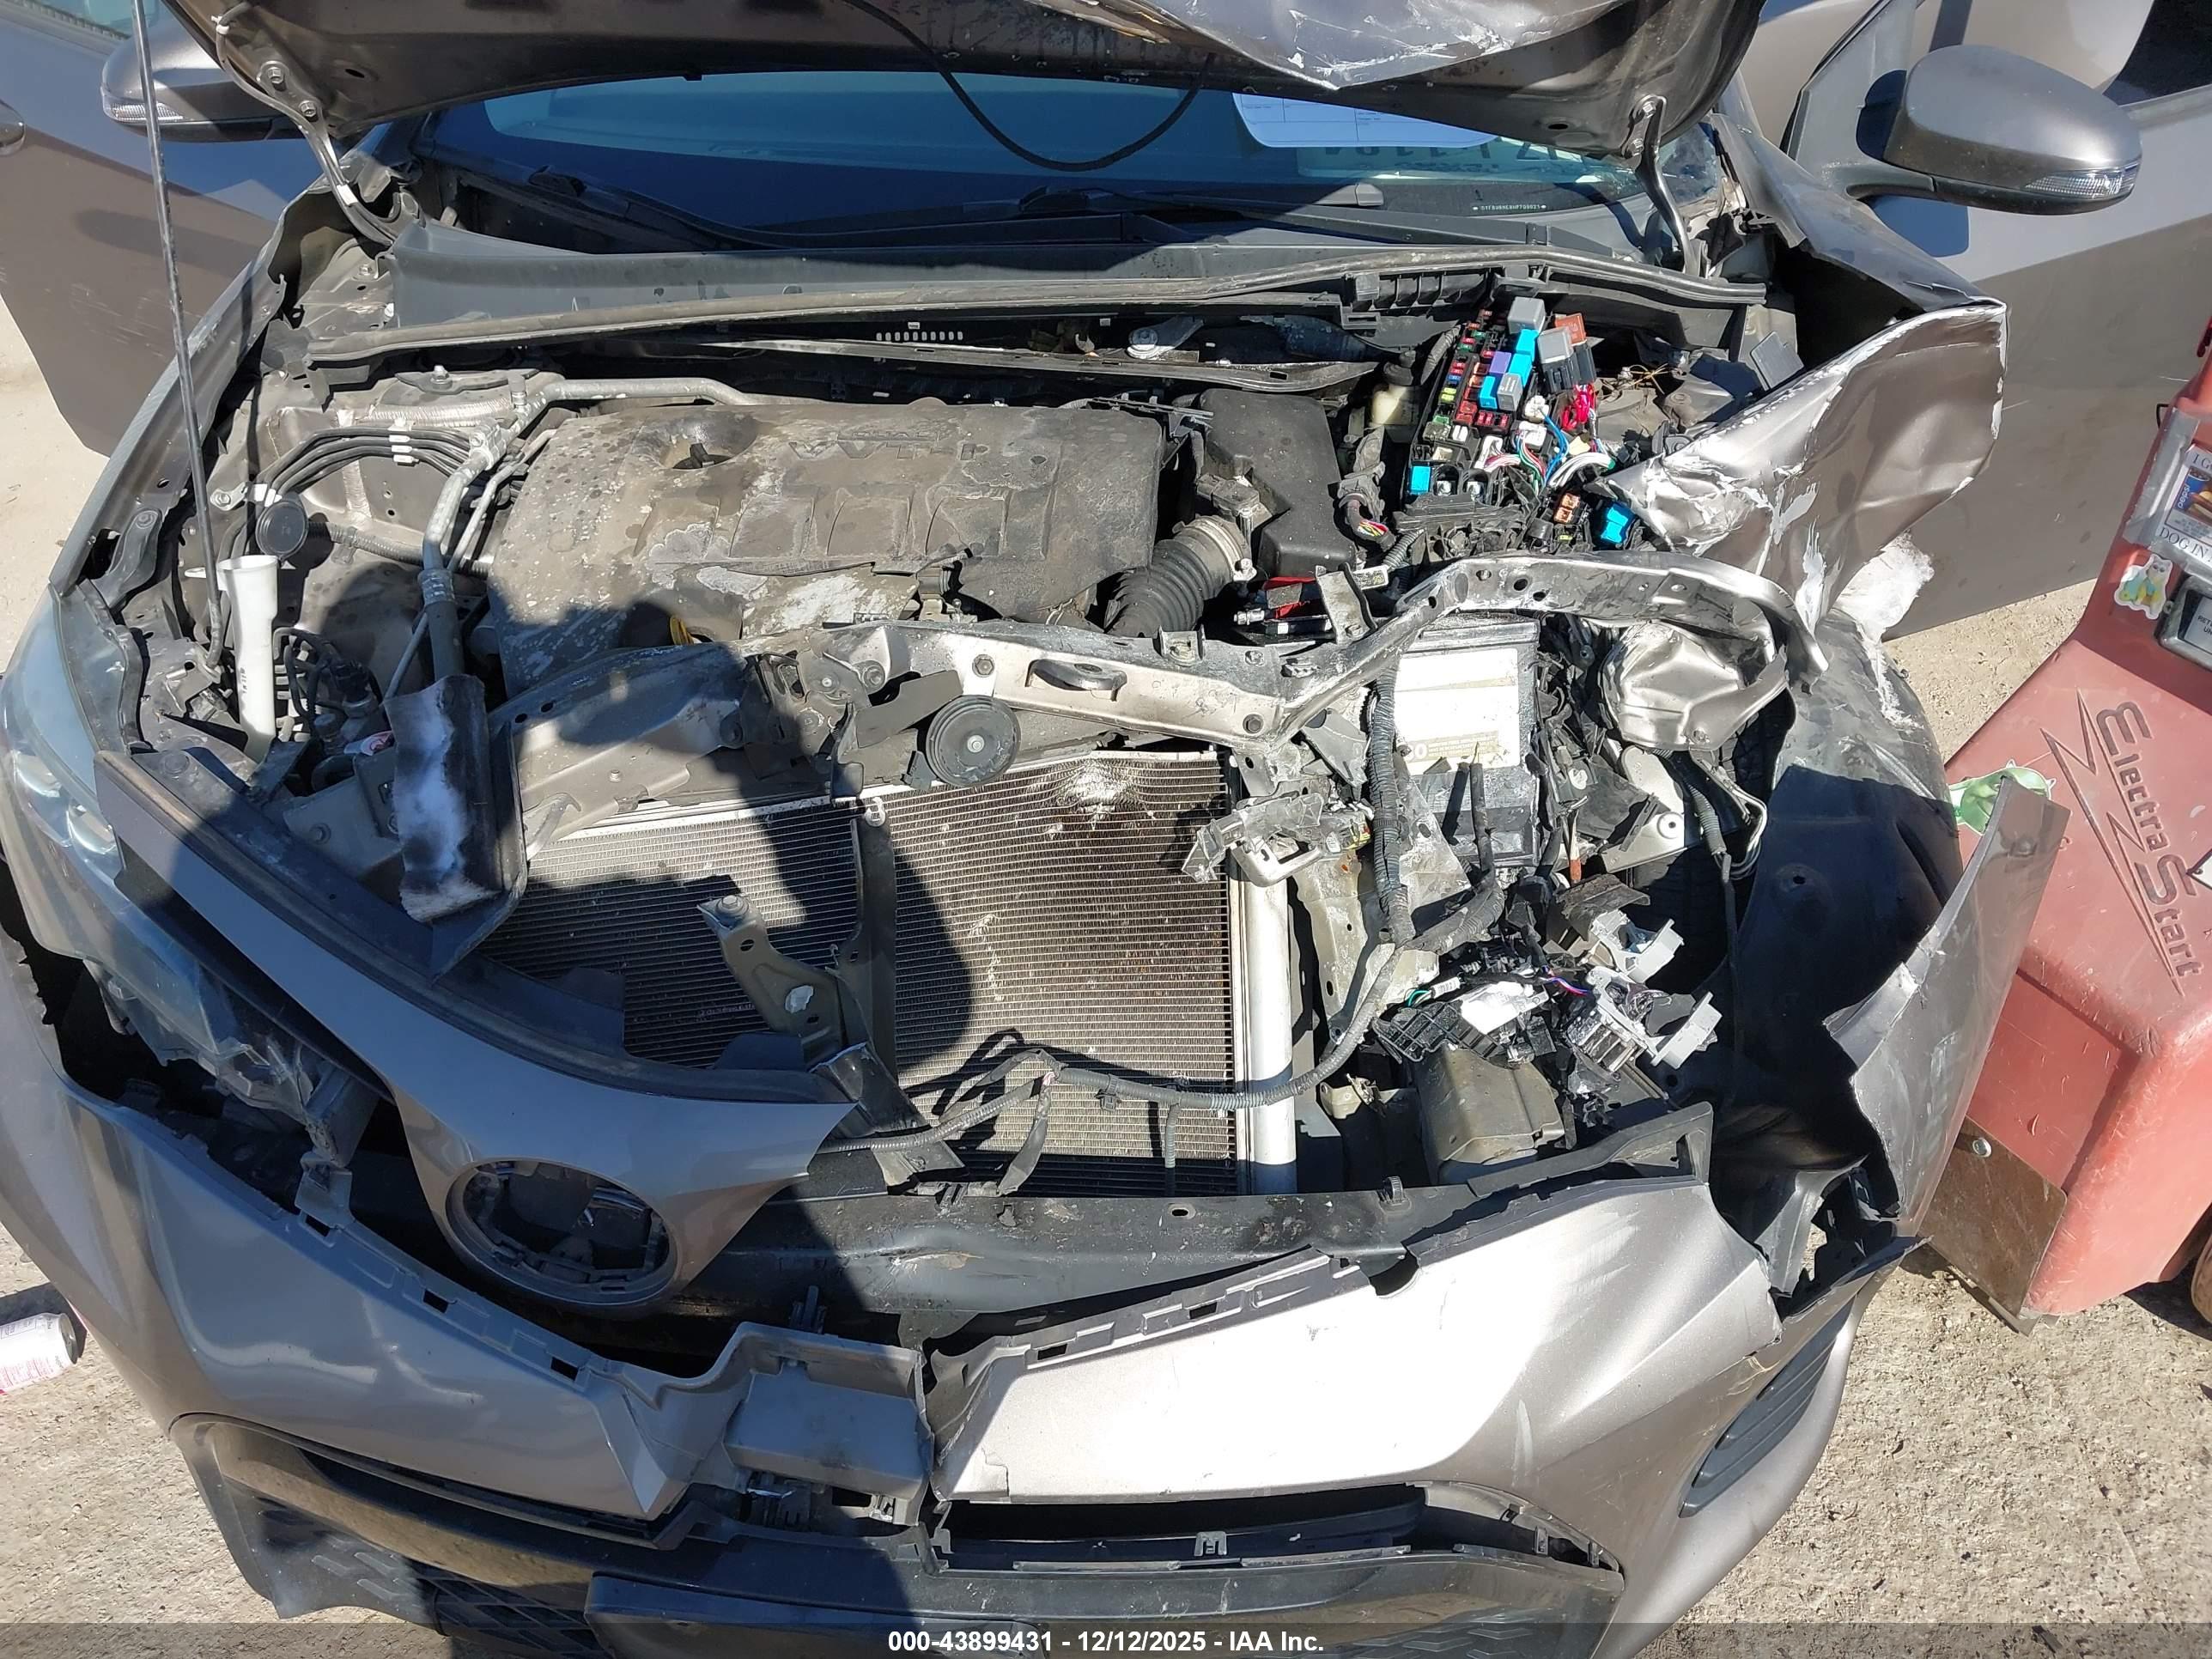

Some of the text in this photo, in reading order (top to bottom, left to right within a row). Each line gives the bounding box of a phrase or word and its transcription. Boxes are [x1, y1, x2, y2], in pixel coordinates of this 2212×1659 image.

[2177, 483, 2191, 509] pepsi
[2159, 526, 2191, 550] DOG
[2191, 543, 2209, 559] IN
[2095, 701, 2204, 977] Electra Start
